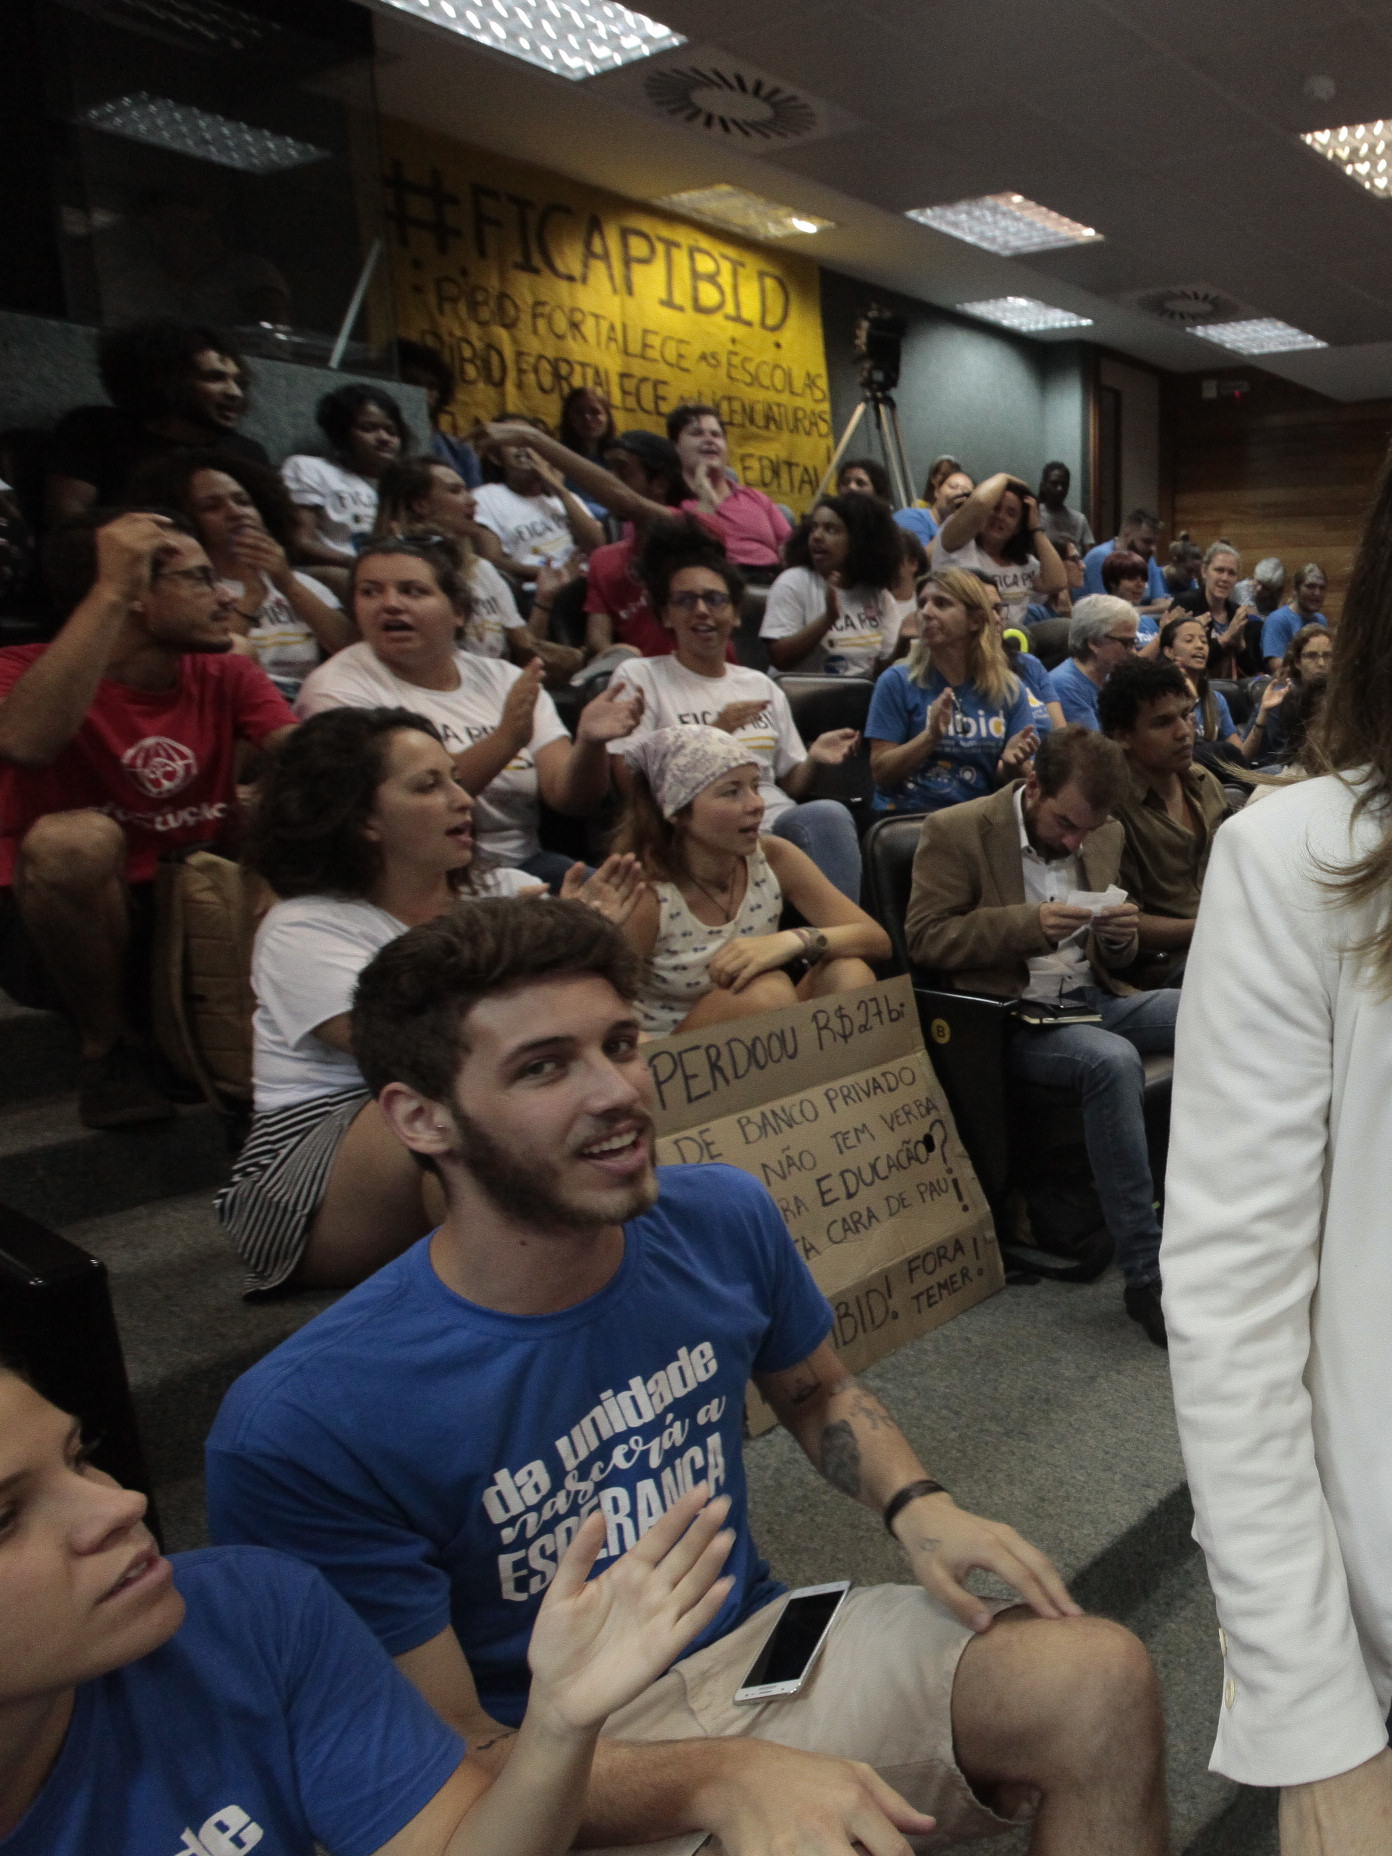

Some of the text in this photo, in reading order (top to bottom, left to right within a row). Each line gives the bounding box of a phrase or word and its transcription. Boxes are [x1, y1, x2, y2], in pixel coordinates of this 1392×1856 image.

[382, 158, 791, 334] #FICAPIBID
[531, 299, 692, 373] FORTALECE
[726, 350, 827, 403] ESCOLAS
[648, 1025, 799, 1112] PERDOOU
[935, 1024, 946, 1038] B
[673, 1066, 916, 1164] DE BANCO PRIVADO
[760, 1096, 940, 1188] NÃO TEM VERBA
[826, 1206, 881, 1245] CARA
[885, 1191, 913, 1217] DE
[482, 1341, 719, 1525] da unidade
[696, 1395, 727, 1426] a
